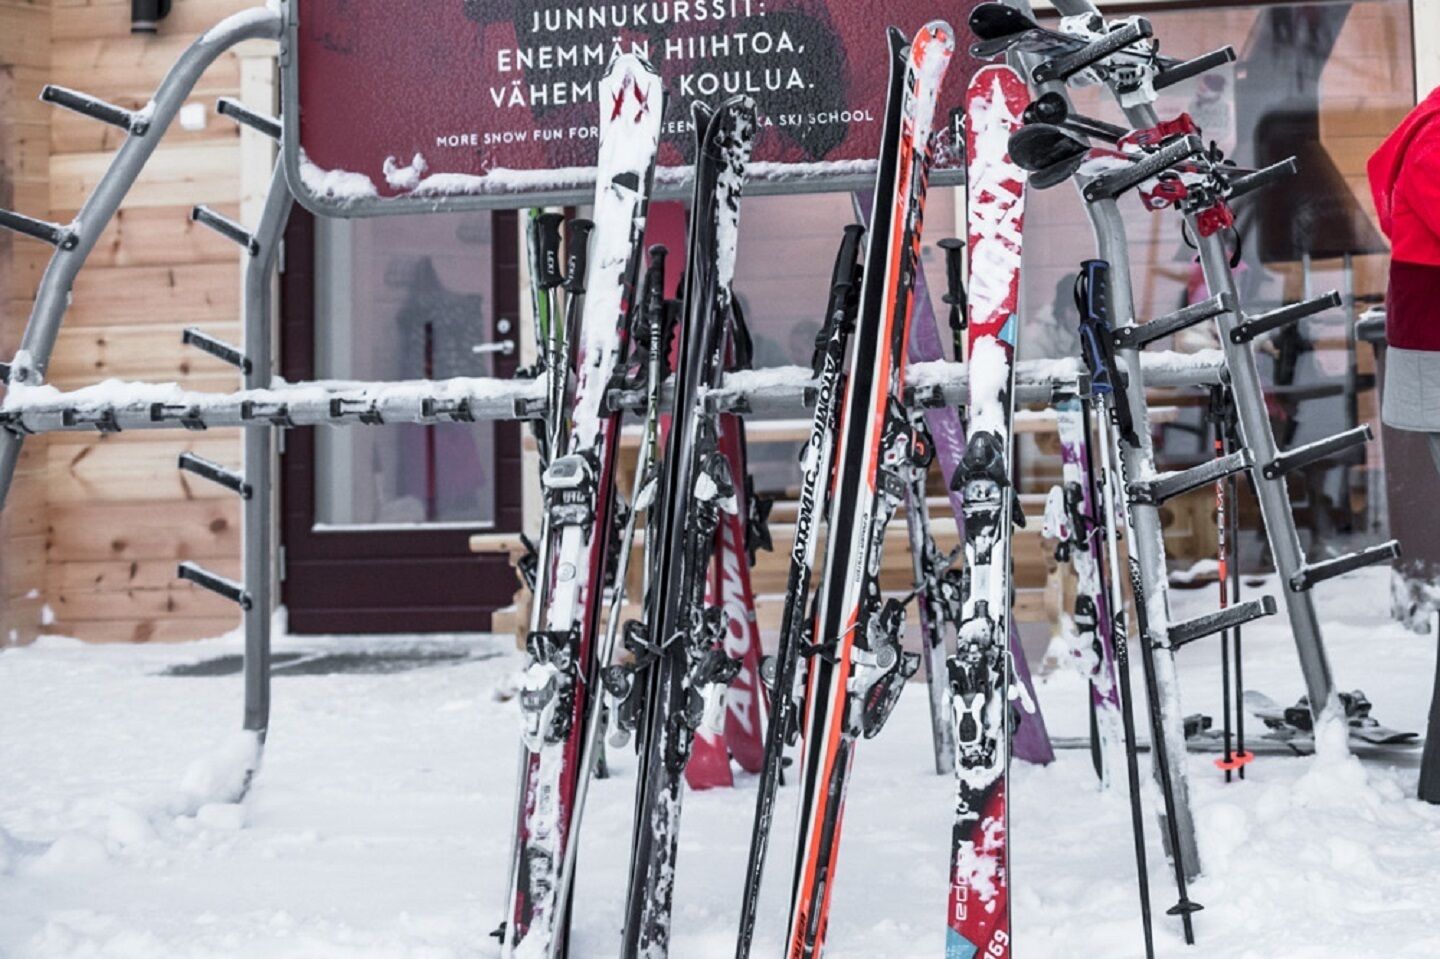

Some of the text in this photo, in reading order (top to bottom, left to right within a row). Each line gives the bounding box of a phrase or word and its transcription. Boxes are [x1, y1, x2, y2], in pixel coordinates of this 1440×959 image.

[497, 30, 805, 72] ENEMMÄN HIIHTOA,
[489, 67, 815, 108] VÄHEM KOULUA.
[436, 134, 479, 148] MORE
[484, 130, 527, 145] SNOW
[533, 129, 563, 141] FUN
[569, 126, 599, 139] FOR
[779, 113, 802, 126] SKI
[808, 109, 874, 126] SCHOOL
[811, 351, 837, 450] ATOMIC
